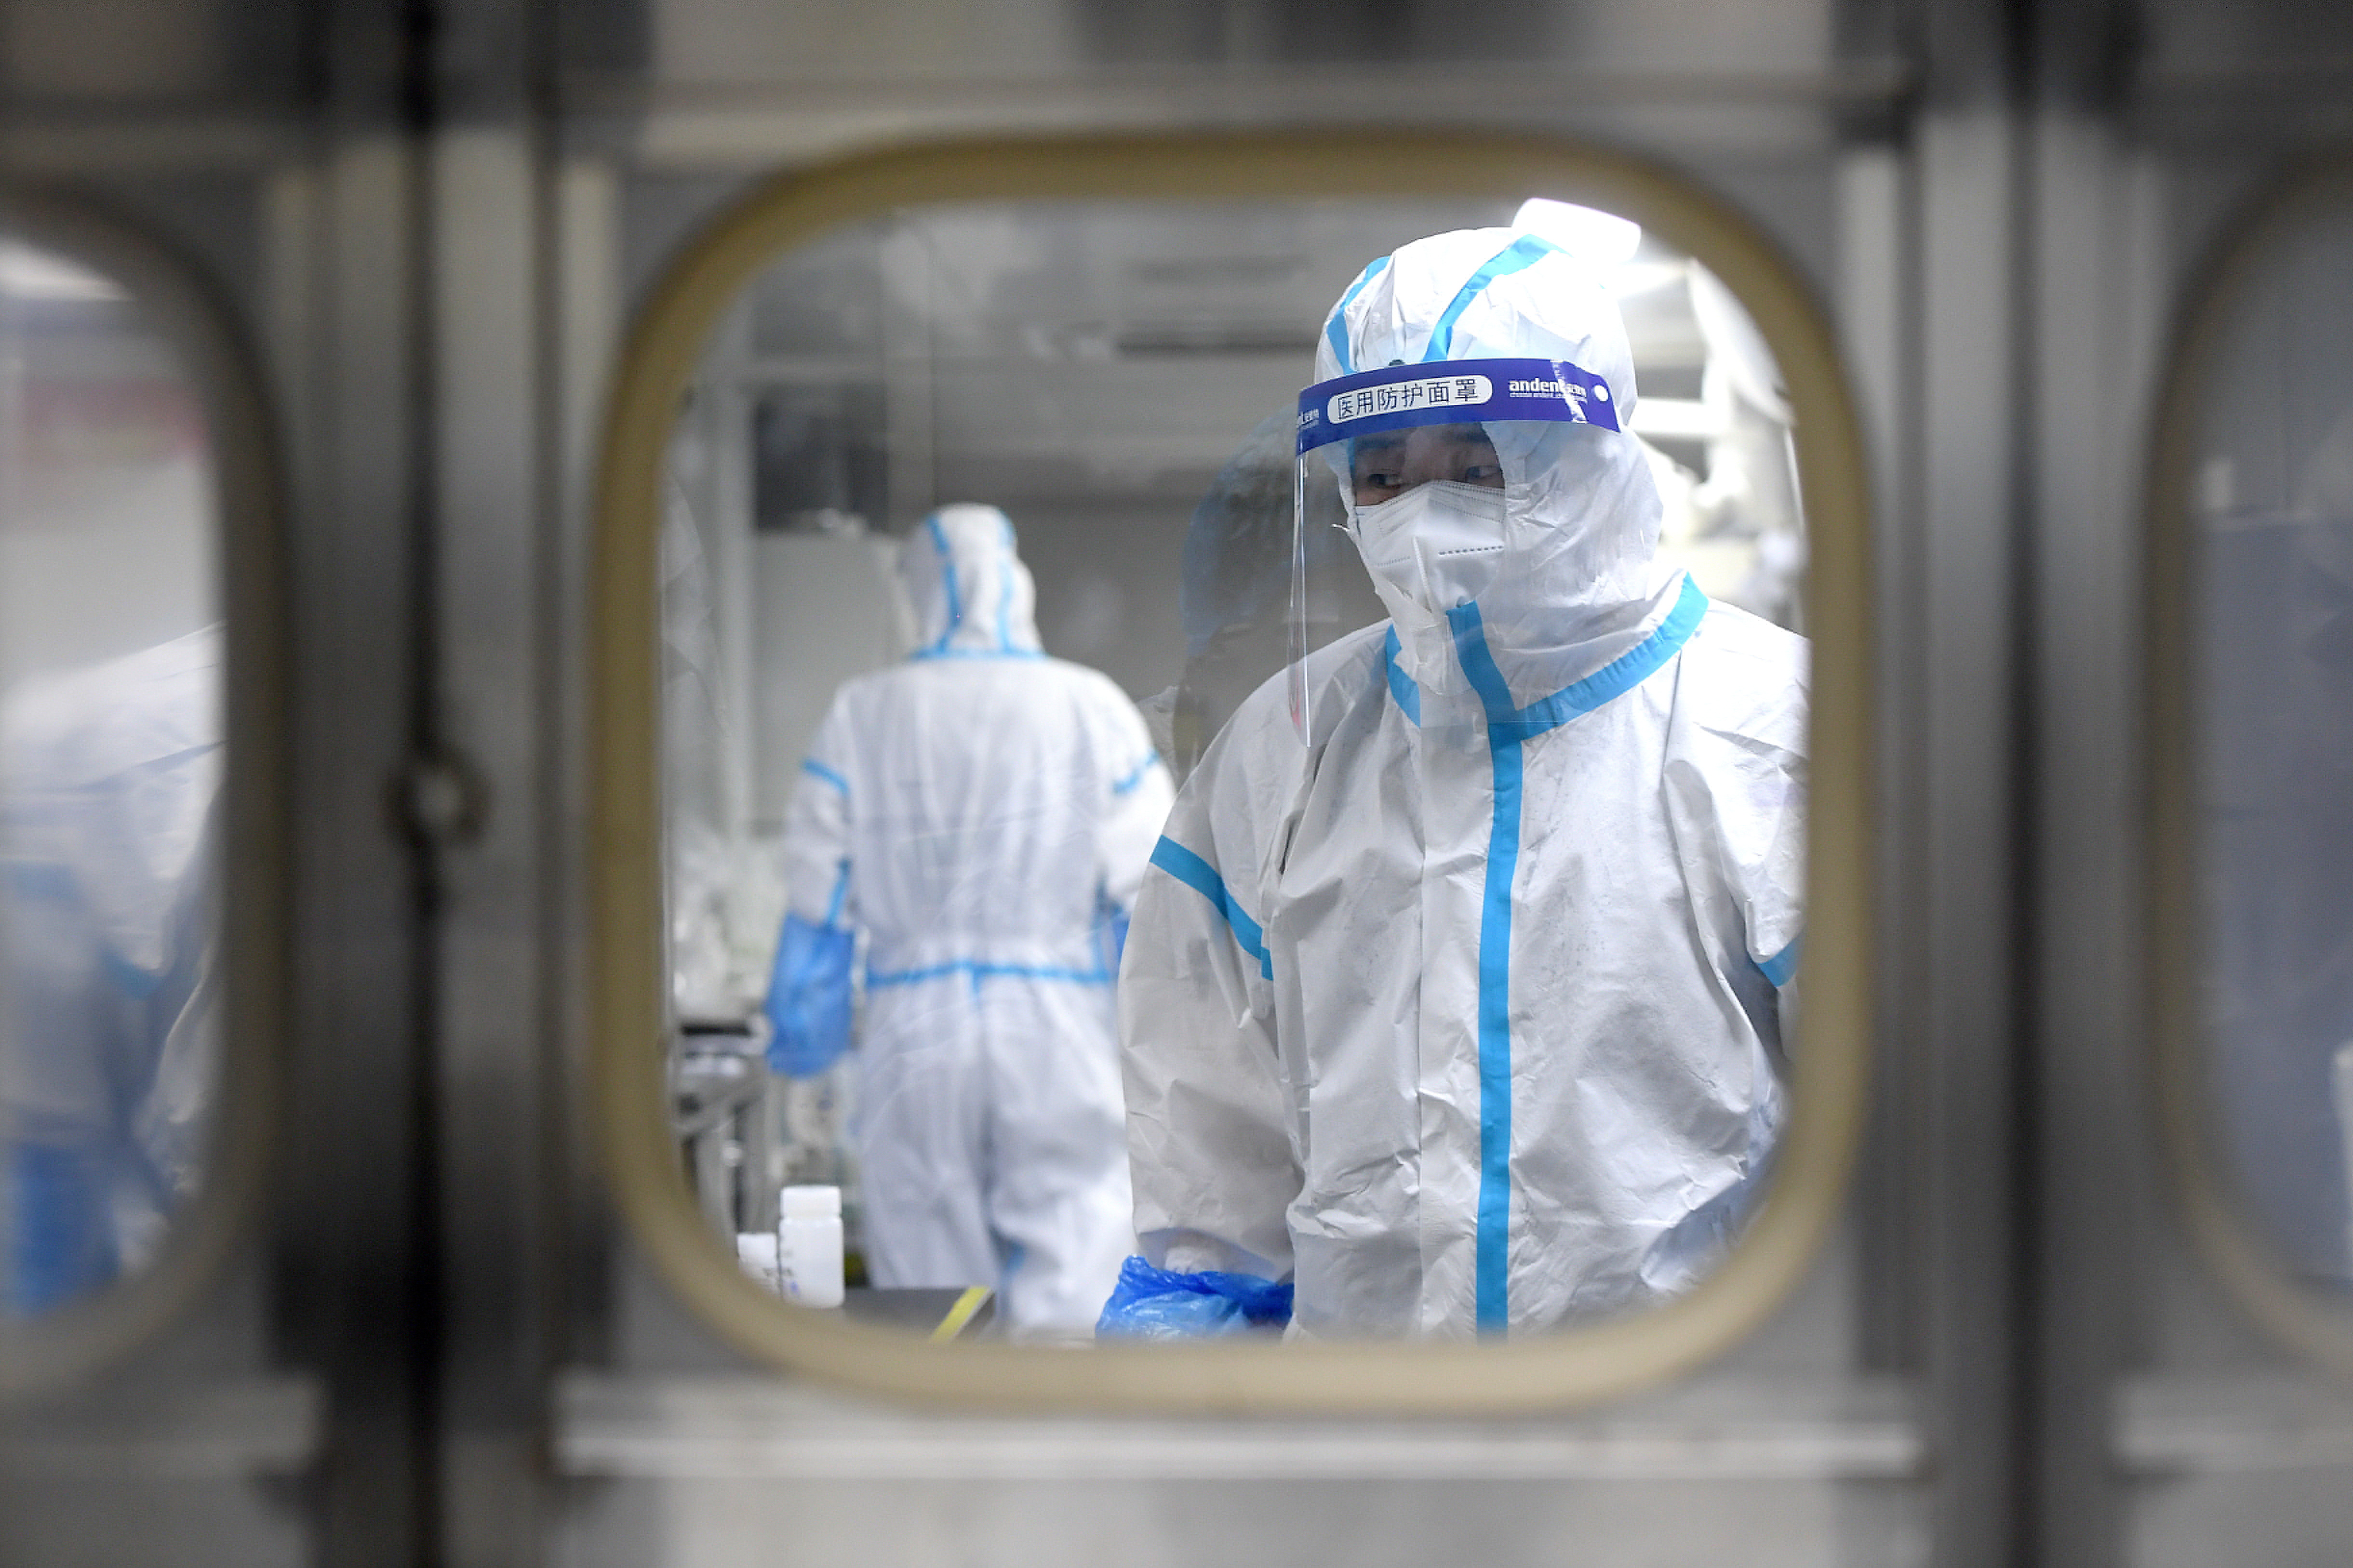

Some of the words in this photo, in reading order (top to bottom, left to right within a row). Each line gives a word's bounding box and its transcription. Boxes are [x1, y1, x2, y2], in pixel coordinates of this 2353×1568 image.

[1337, 378, 1480, 420] 医用防护面罩
